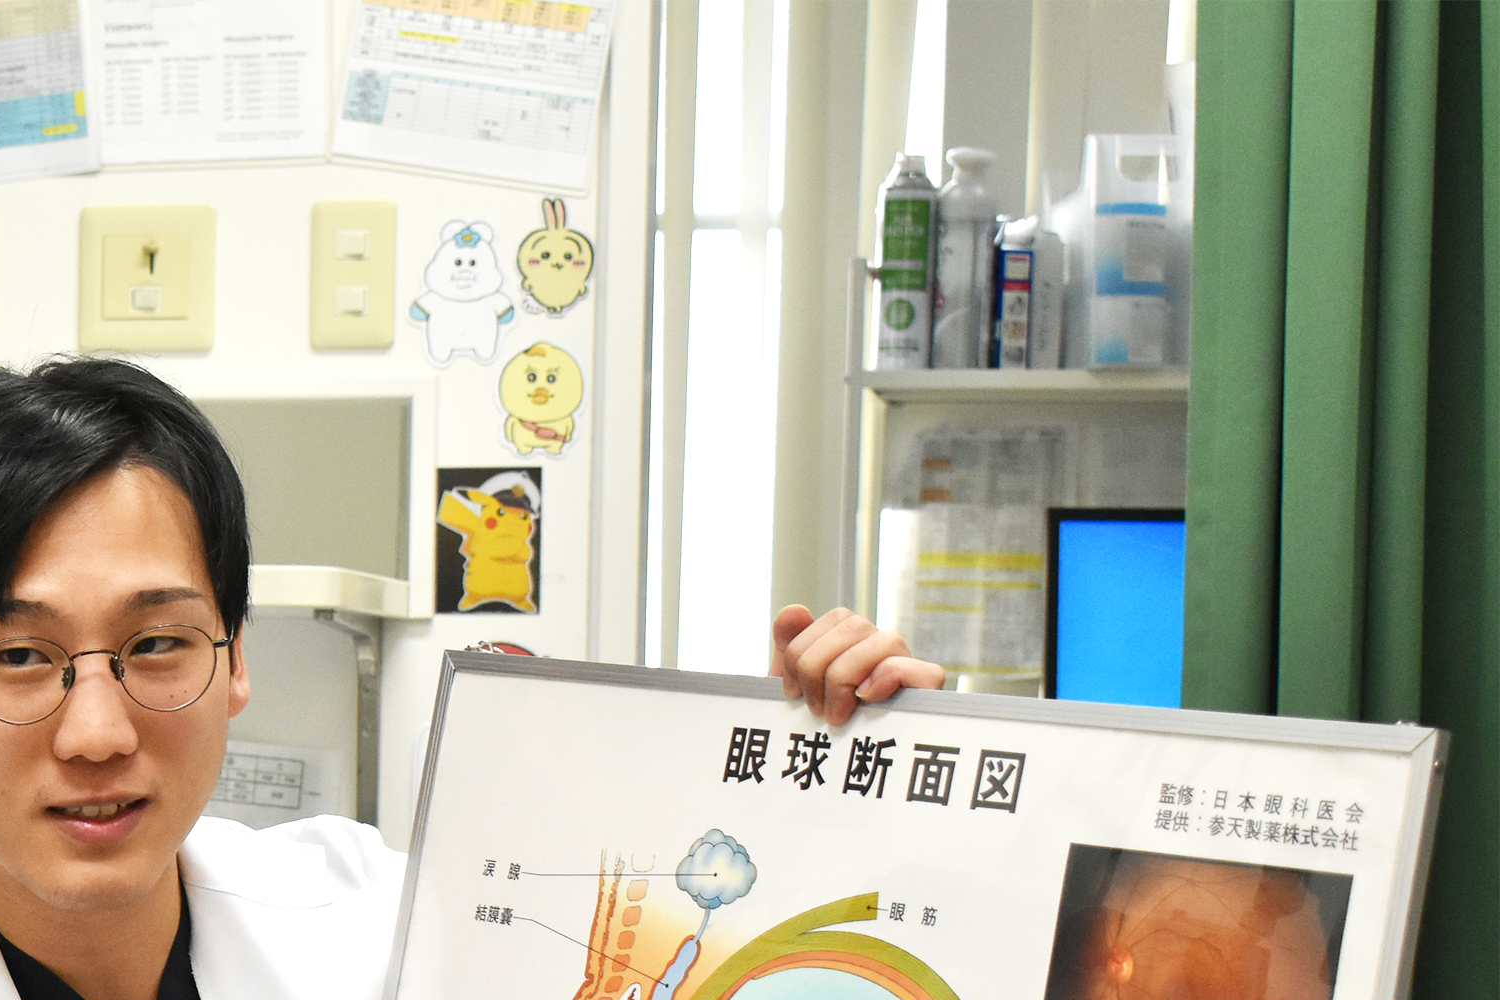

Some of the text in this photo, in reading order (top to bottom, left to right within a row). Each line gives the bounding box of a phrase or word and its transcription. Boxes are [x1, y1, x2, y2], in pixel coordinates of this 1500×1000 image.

[722, 726, 1026, 814] 眼球断面図
[888, 902, 938, 927] 眼筋
